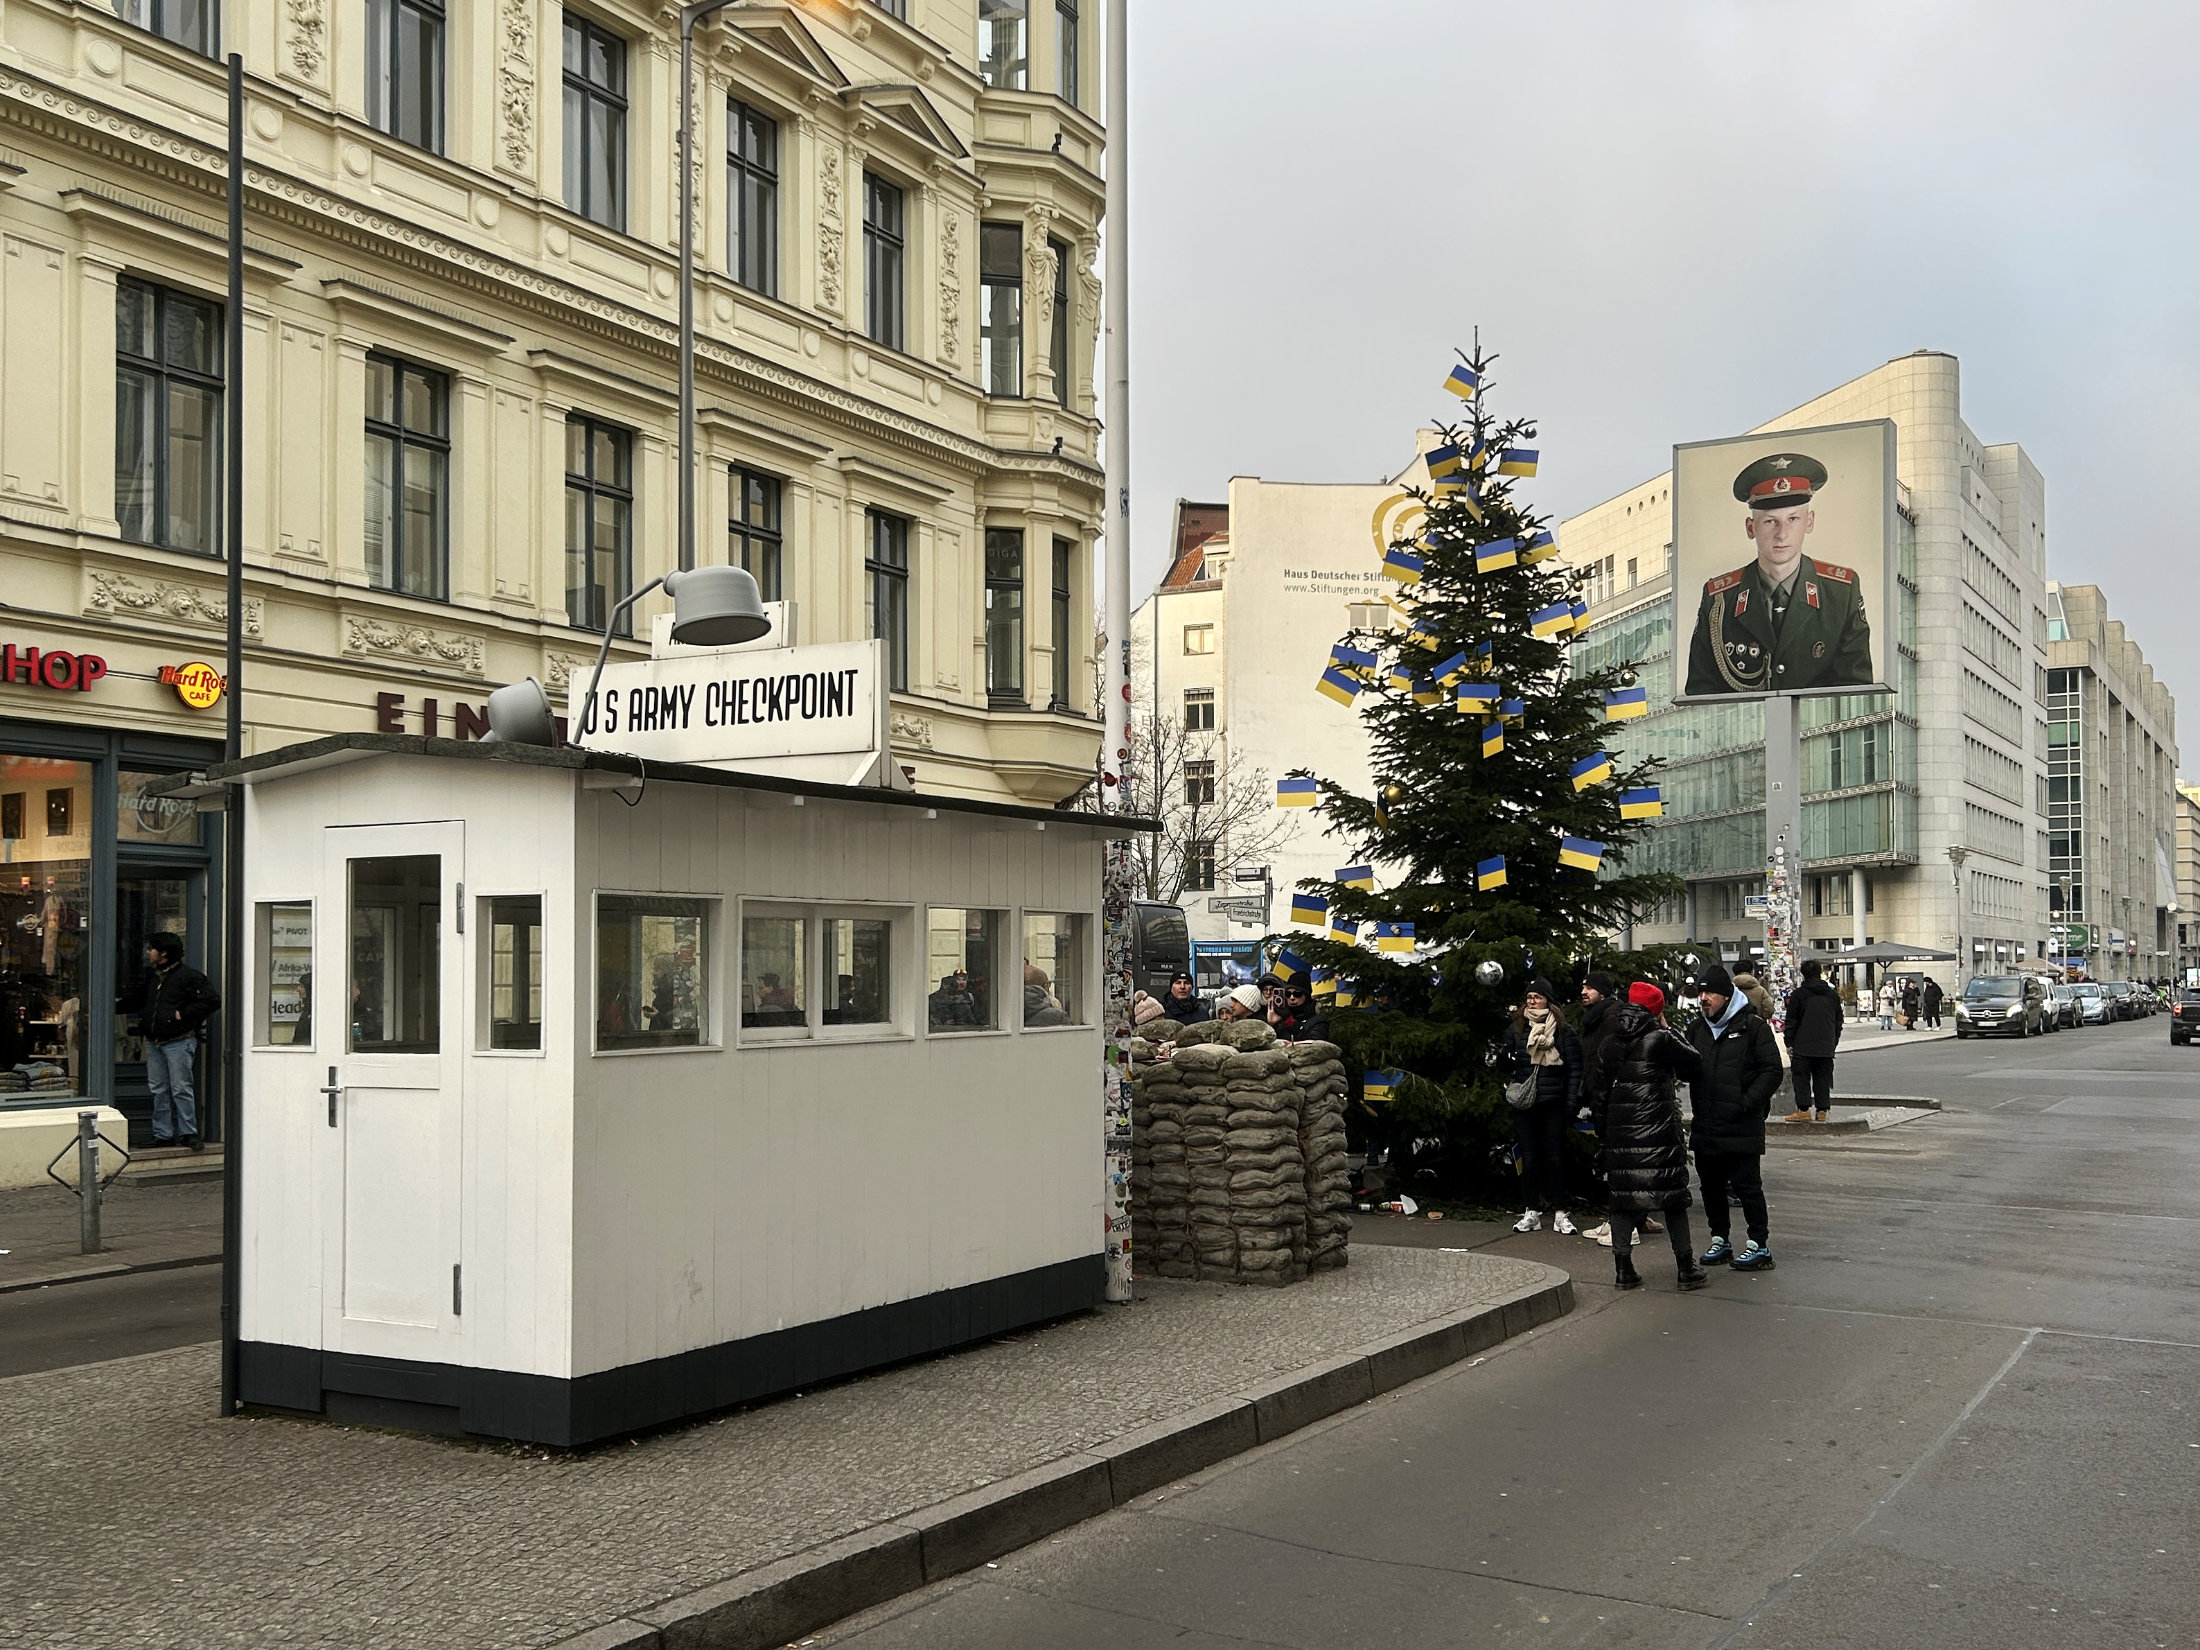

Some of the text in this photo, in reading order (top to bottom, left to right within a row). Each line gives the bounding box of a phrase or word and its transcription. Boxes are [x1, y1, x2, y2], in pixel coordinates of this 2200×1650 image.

[1284, 569, 1308, 579] Haus
[1311, 570, 1360, 580] Deutscher
[1283, 583, 1379, 597] www.Stiftungen.org
[0, 644, 107, 692] HOP
[161, 665, 228, 692] Hard Roc
[190, 692, 211, 701] CAFE
[585, 669, 859, 735] U S ARMY CHECKPOINT
[118, 792, 196, 817] Hard Rock
